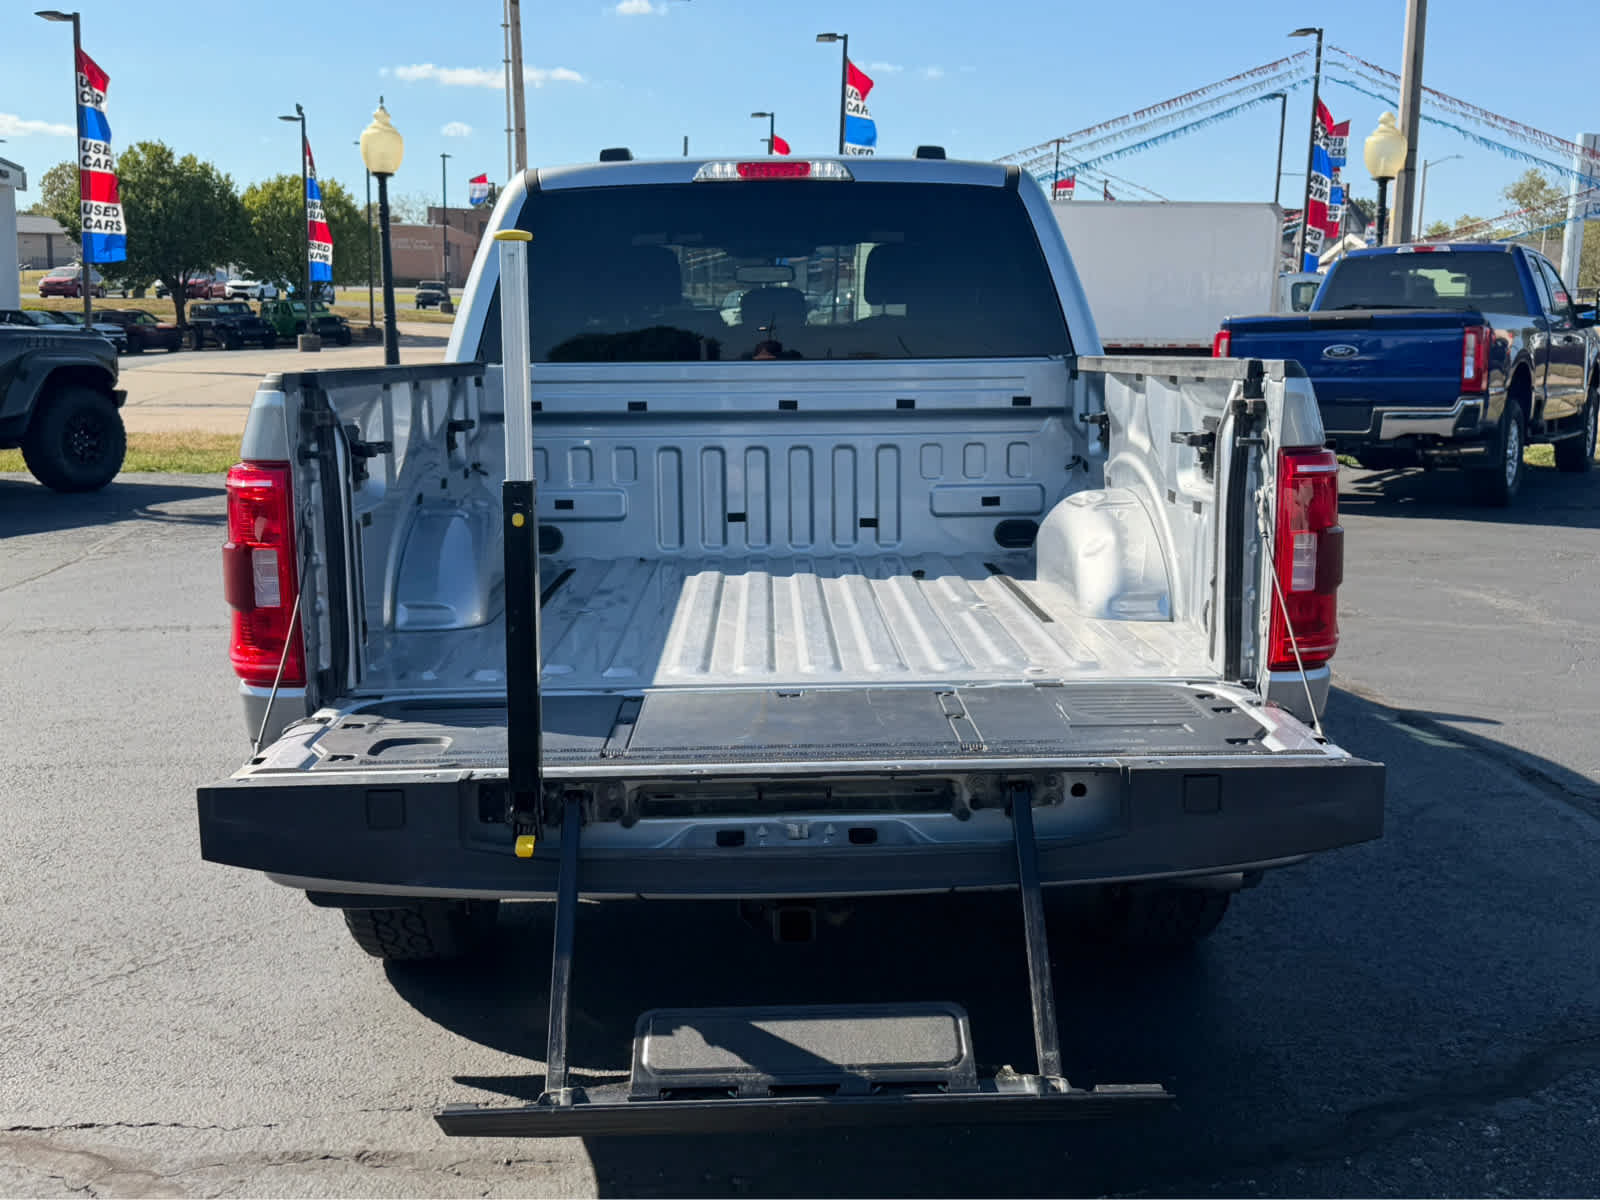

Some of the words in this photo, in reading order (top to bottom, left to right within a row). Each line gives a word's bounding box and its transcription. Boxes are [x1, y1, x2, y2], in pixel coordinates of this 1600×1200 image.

[82, 140, 111, 156] USE
[82, 154, 113, 170] CAR
[82, 202, 119, 217] USED
[83, 217, 122, 232] CARS
